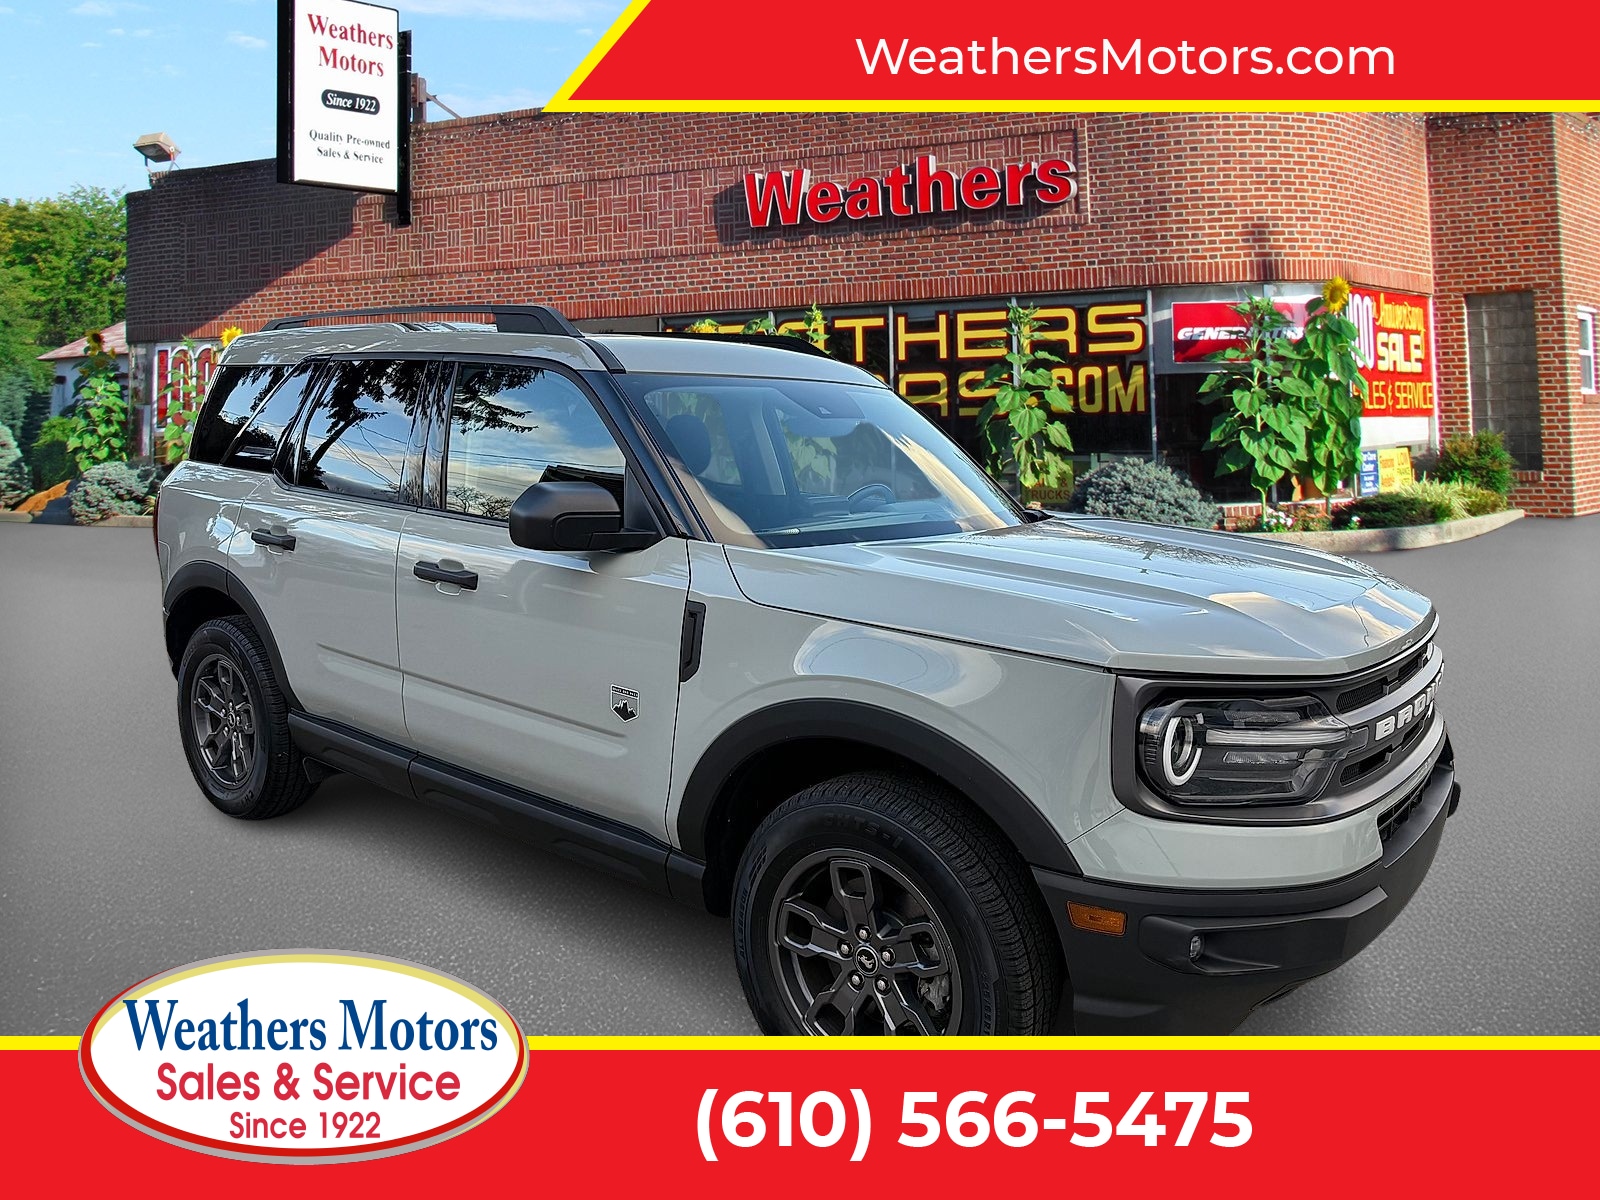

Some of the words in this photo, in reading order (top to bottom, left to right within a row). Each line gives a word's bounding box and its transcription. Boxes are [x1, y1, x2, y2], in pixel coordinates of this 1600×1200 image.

[307, 13, 394, 50] Weathers
[319, 45, 385, 77] Motors
[326, 92, 353, 108] Since
[354, 97, 377, 112] 1922
[309, 129, 343, 145] Quality
[346, 133, 391, 150] Pre-owned
[317, 146, 341, 158] Sales
[343, 150, 351, 160] &
[353, 151, 384, 165] Service
[744, 155, 1076, 228] Weathers
[1376, 331, 1423, 374] SALE
[1394, 381, 1434, 410] SERVICE
